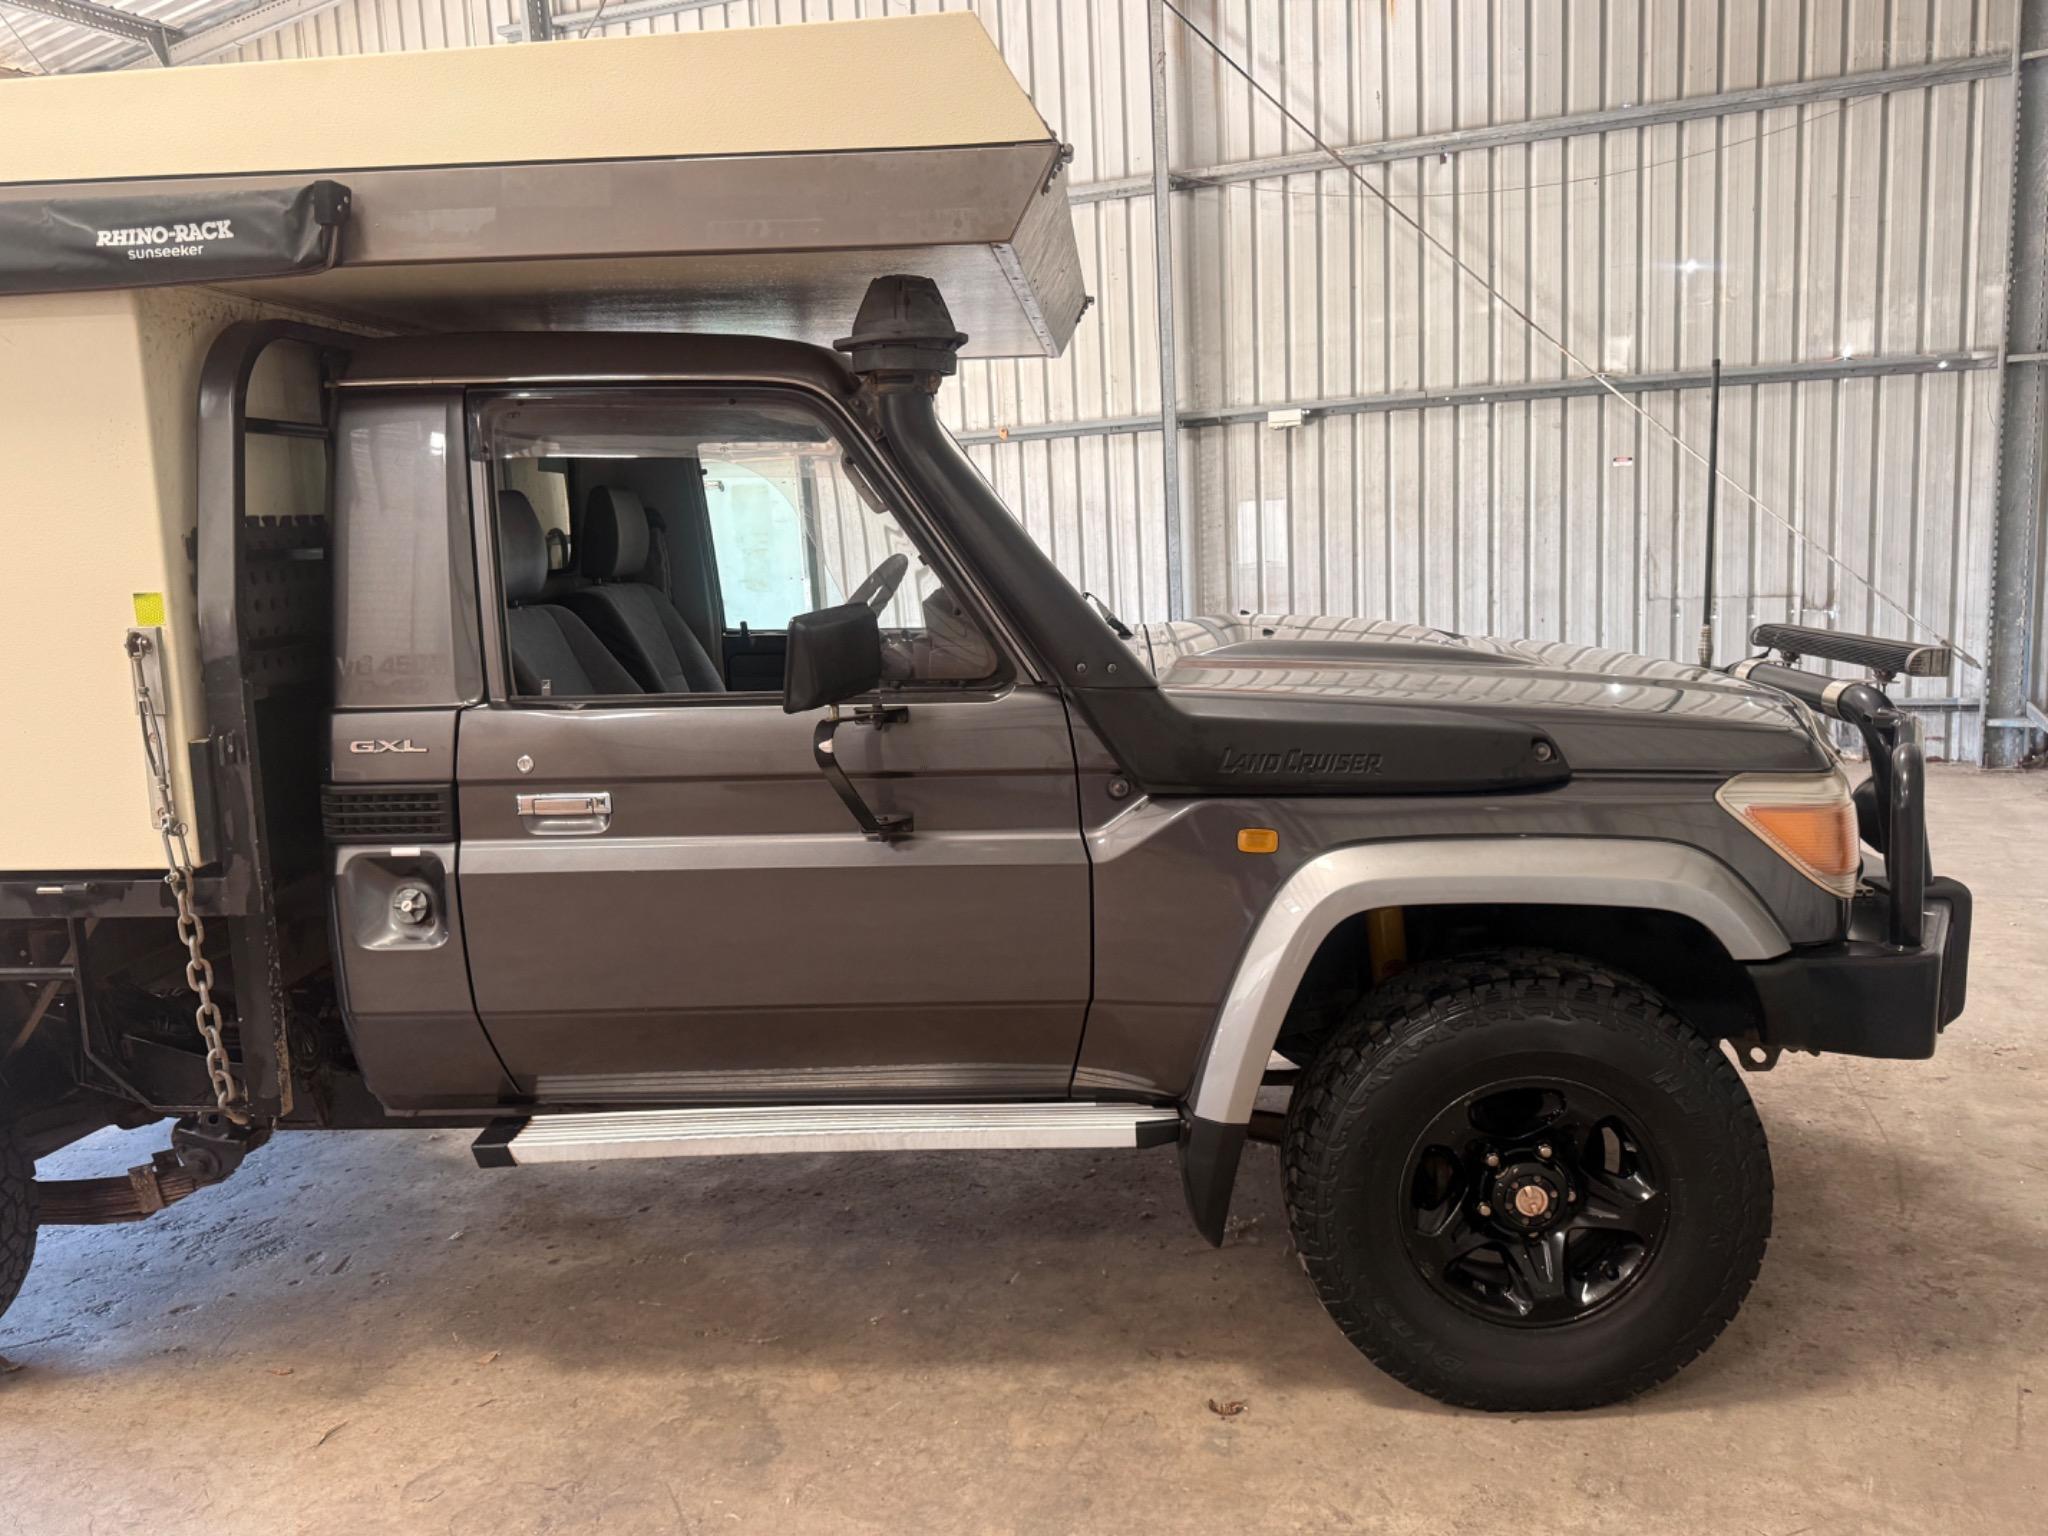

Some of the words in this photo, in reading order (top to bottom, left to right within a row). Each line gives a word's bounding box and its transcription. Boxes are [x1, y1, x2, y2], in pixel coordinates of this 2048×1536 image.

[96, 219, 234, 247] RHINO-RACK
[128, 245, 204, 260] sunseeker
[350, 739, 429, 754] GXL
[1218, 747, 1283, 774] LAND
[1284, 748, 1384, 775] CRUISER
